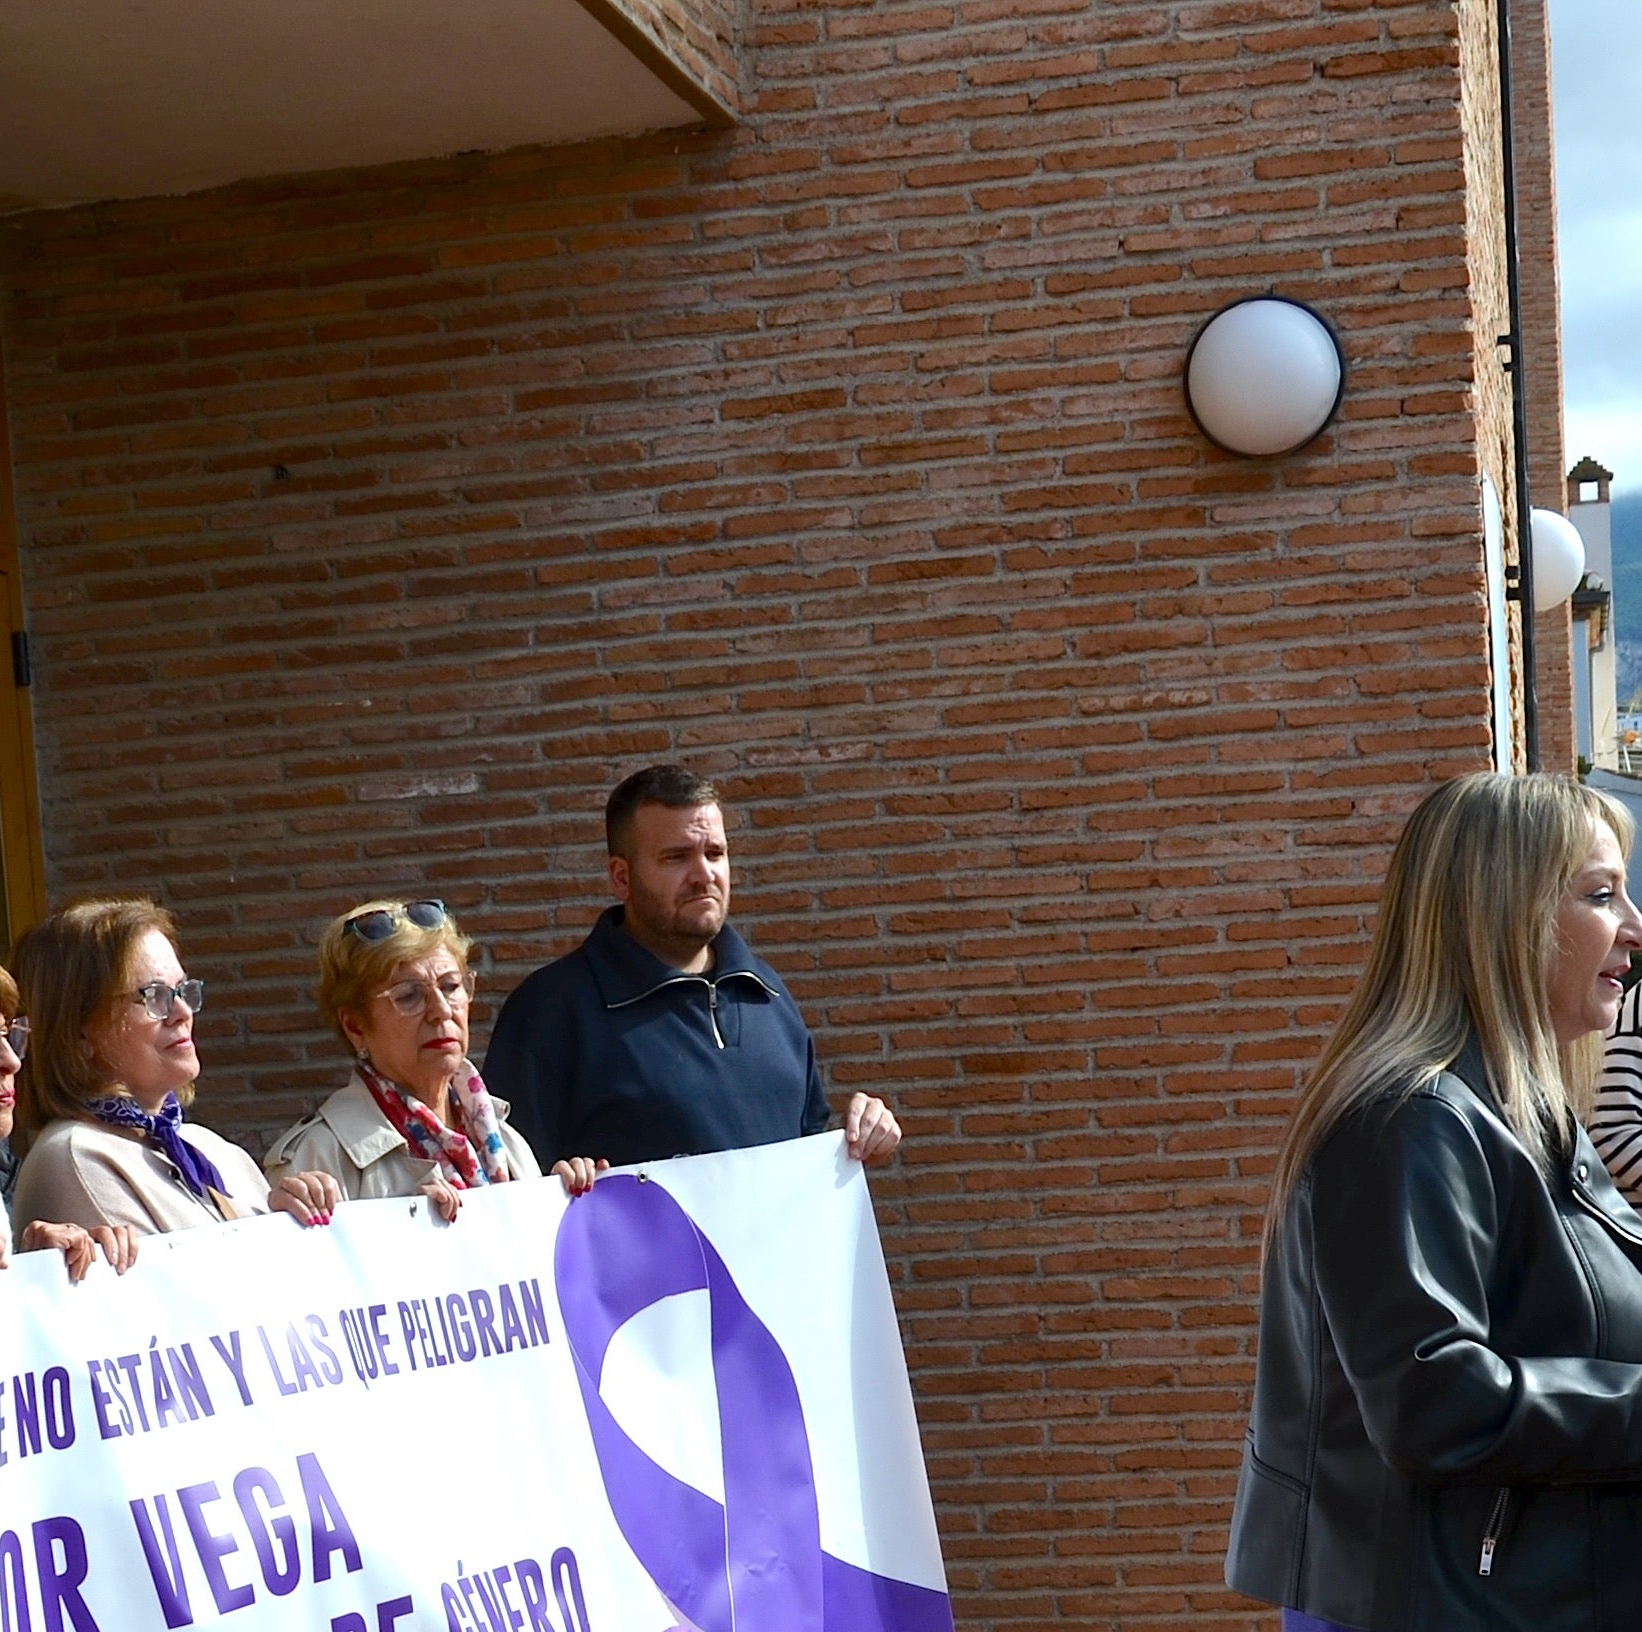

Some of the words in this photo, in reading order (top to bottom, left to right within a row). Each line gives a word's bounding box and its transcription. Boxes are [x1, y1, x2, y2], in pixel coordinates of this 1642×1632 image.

[13, 1366, 76, 1458] NO
[87, 1336, 215, 1440] ESTÁN
[209, 1331, 253, 1406] Y
[257, 1314, 344, 1396] LAS
[339, 1303, 399, 1391] QUE
[397, 1278, 550, 1371] PELIGRAN
[129, 1452, 363, 1630] VEGA
